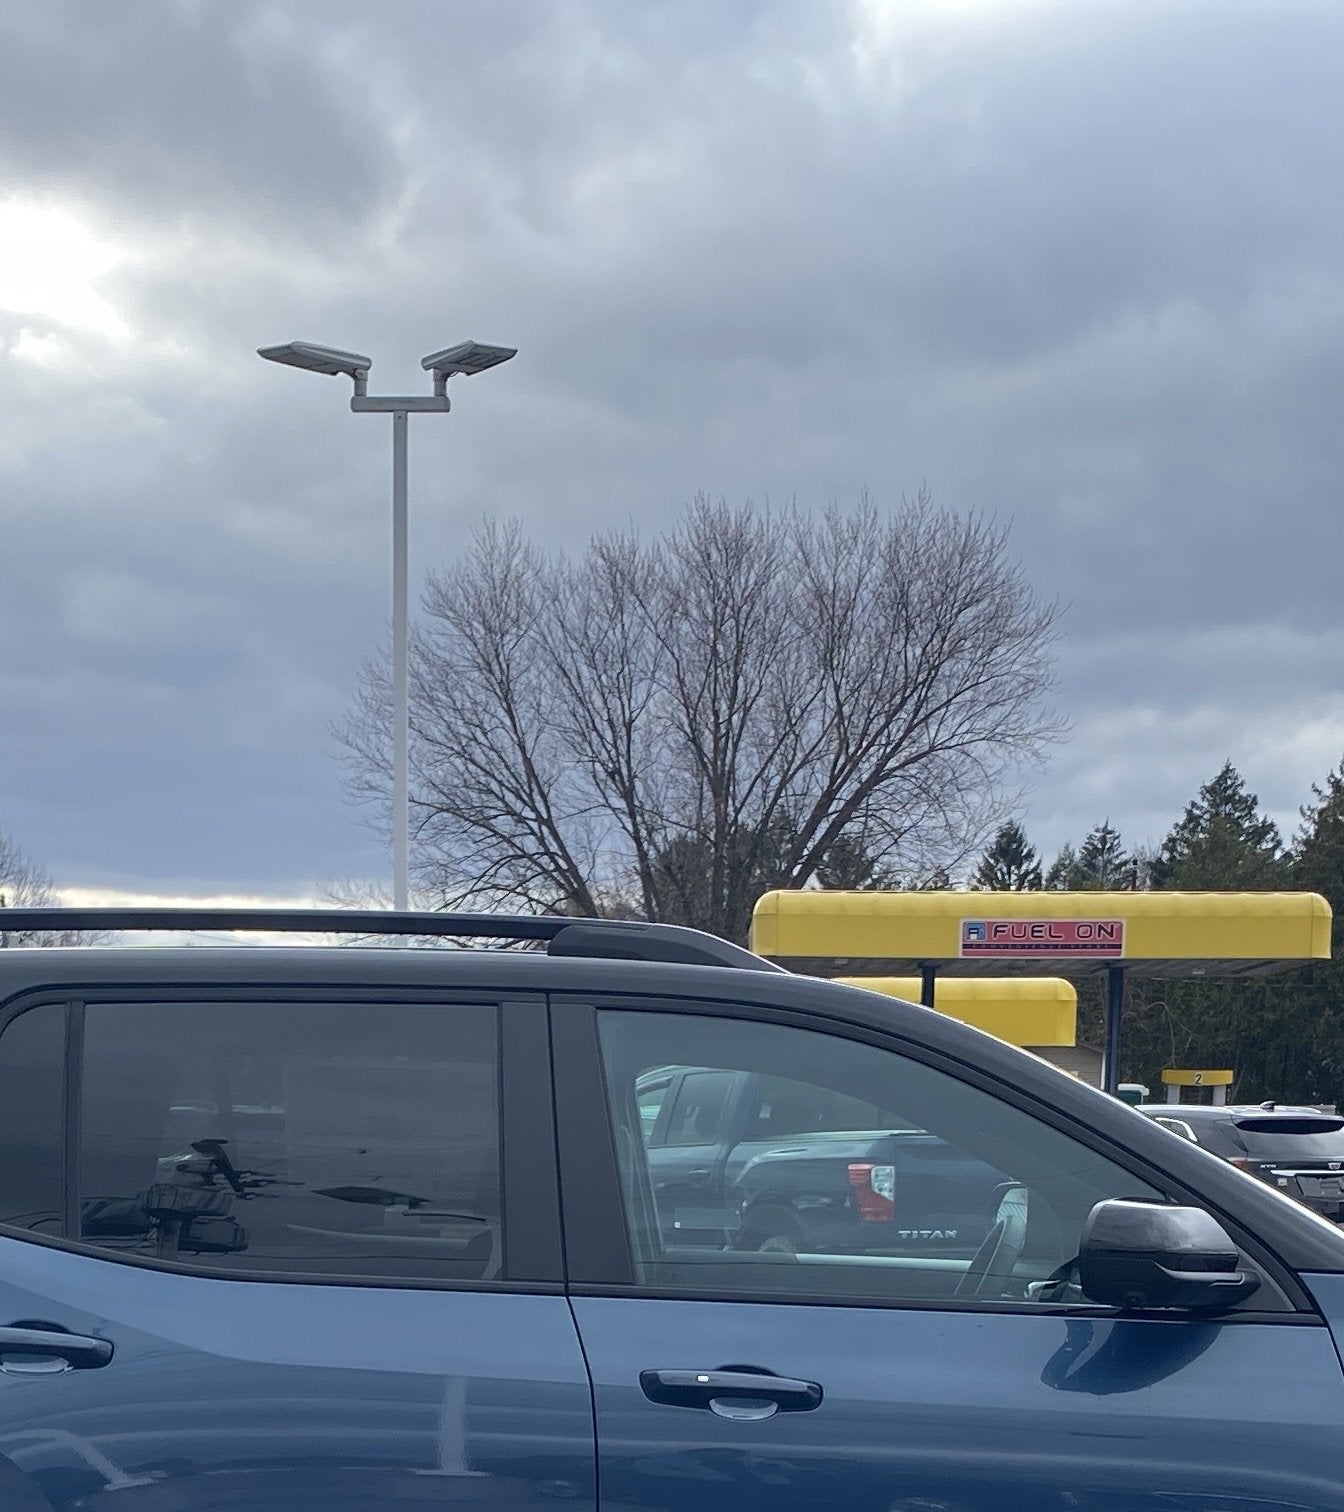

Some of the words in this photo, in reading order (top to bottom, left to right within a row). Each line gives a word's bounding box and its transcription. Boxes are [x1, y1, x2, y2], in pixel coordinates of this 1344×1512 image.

[992, 923, 1064, 939] FUEL
[1075, 923, 1116, 940] ON
[1195, 1073, 1202, 1085] 2
[898, 1230, 958, 1239] TITAN
